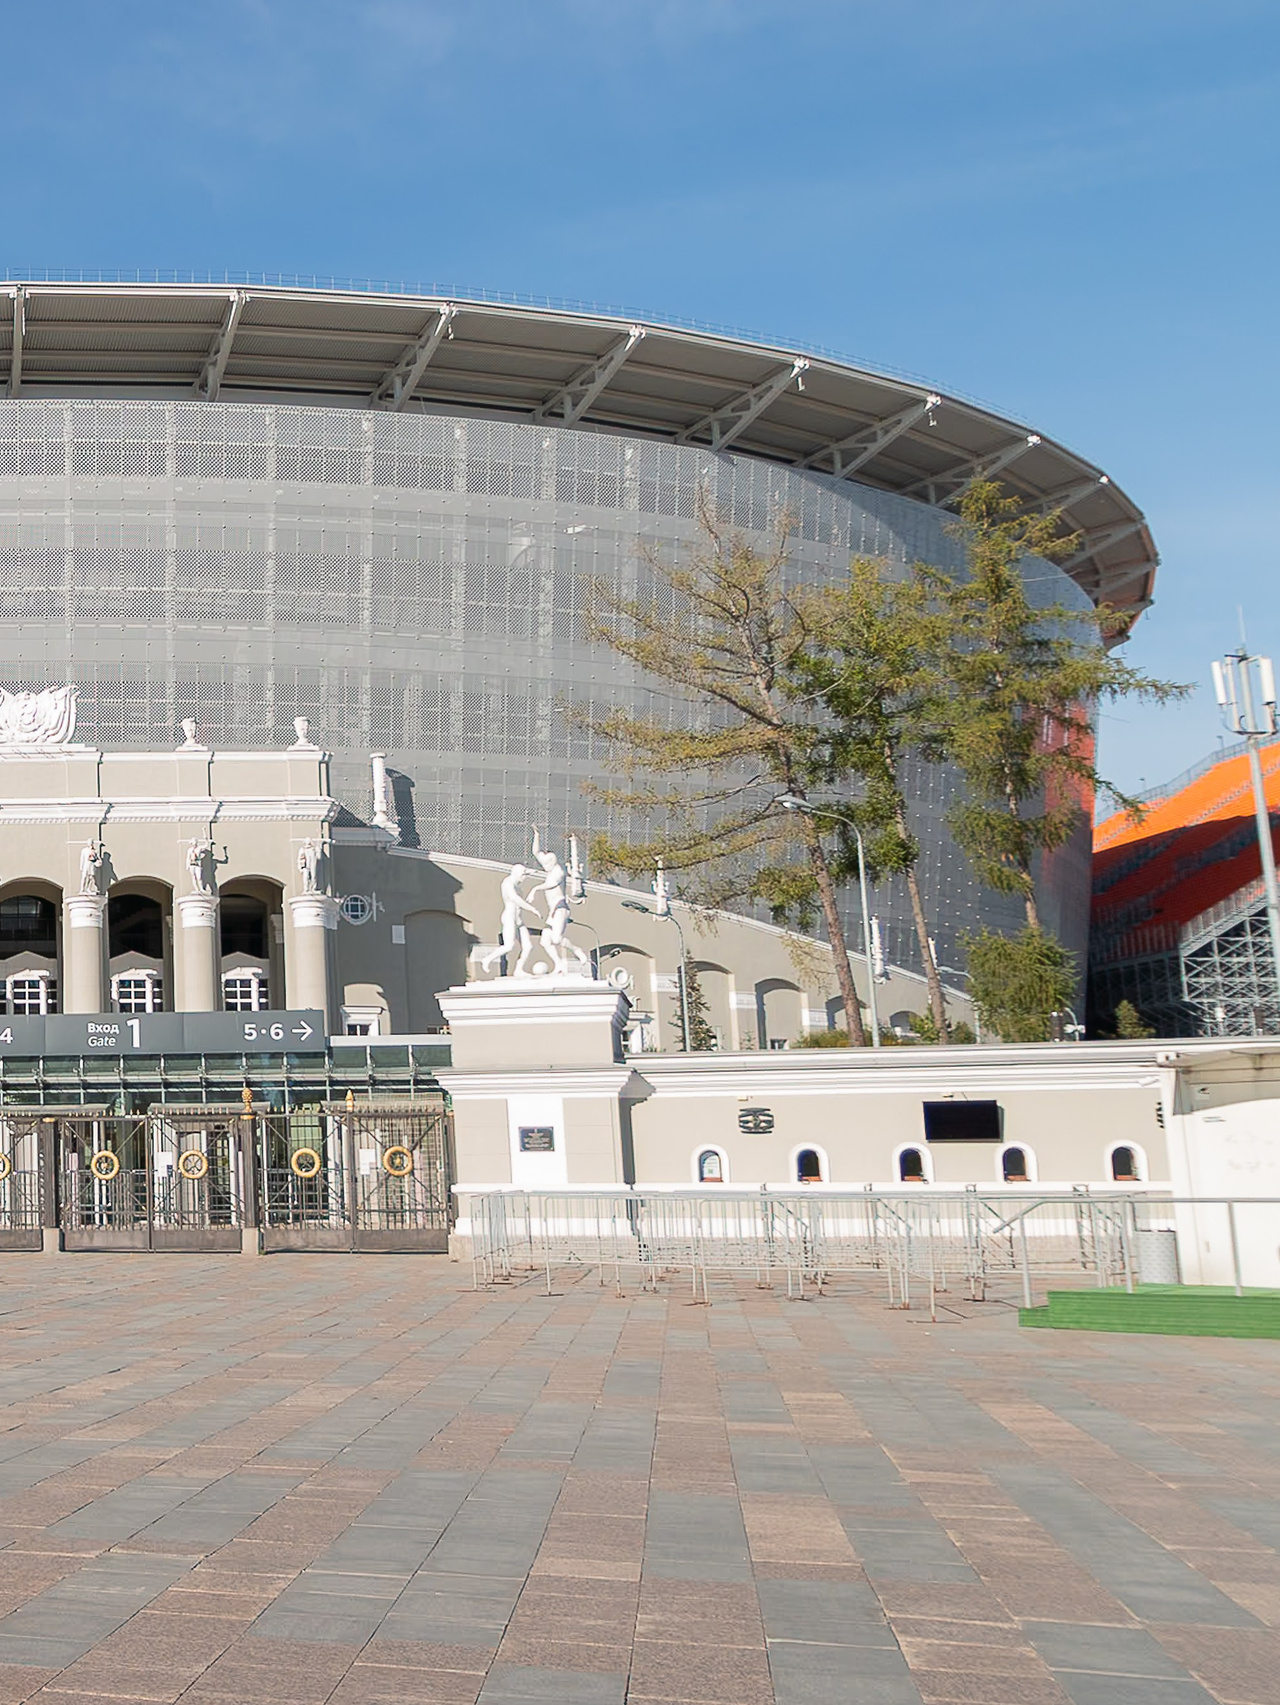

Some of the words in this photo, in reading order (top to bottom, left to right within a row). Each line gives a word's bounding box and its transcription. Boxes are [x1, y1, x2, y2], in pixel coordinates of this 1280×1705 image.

[87, 1022, 120, 1035] Вход
[126, 1018, 141, 1048] 1
[87, 1035, 116, 1047] Gate
